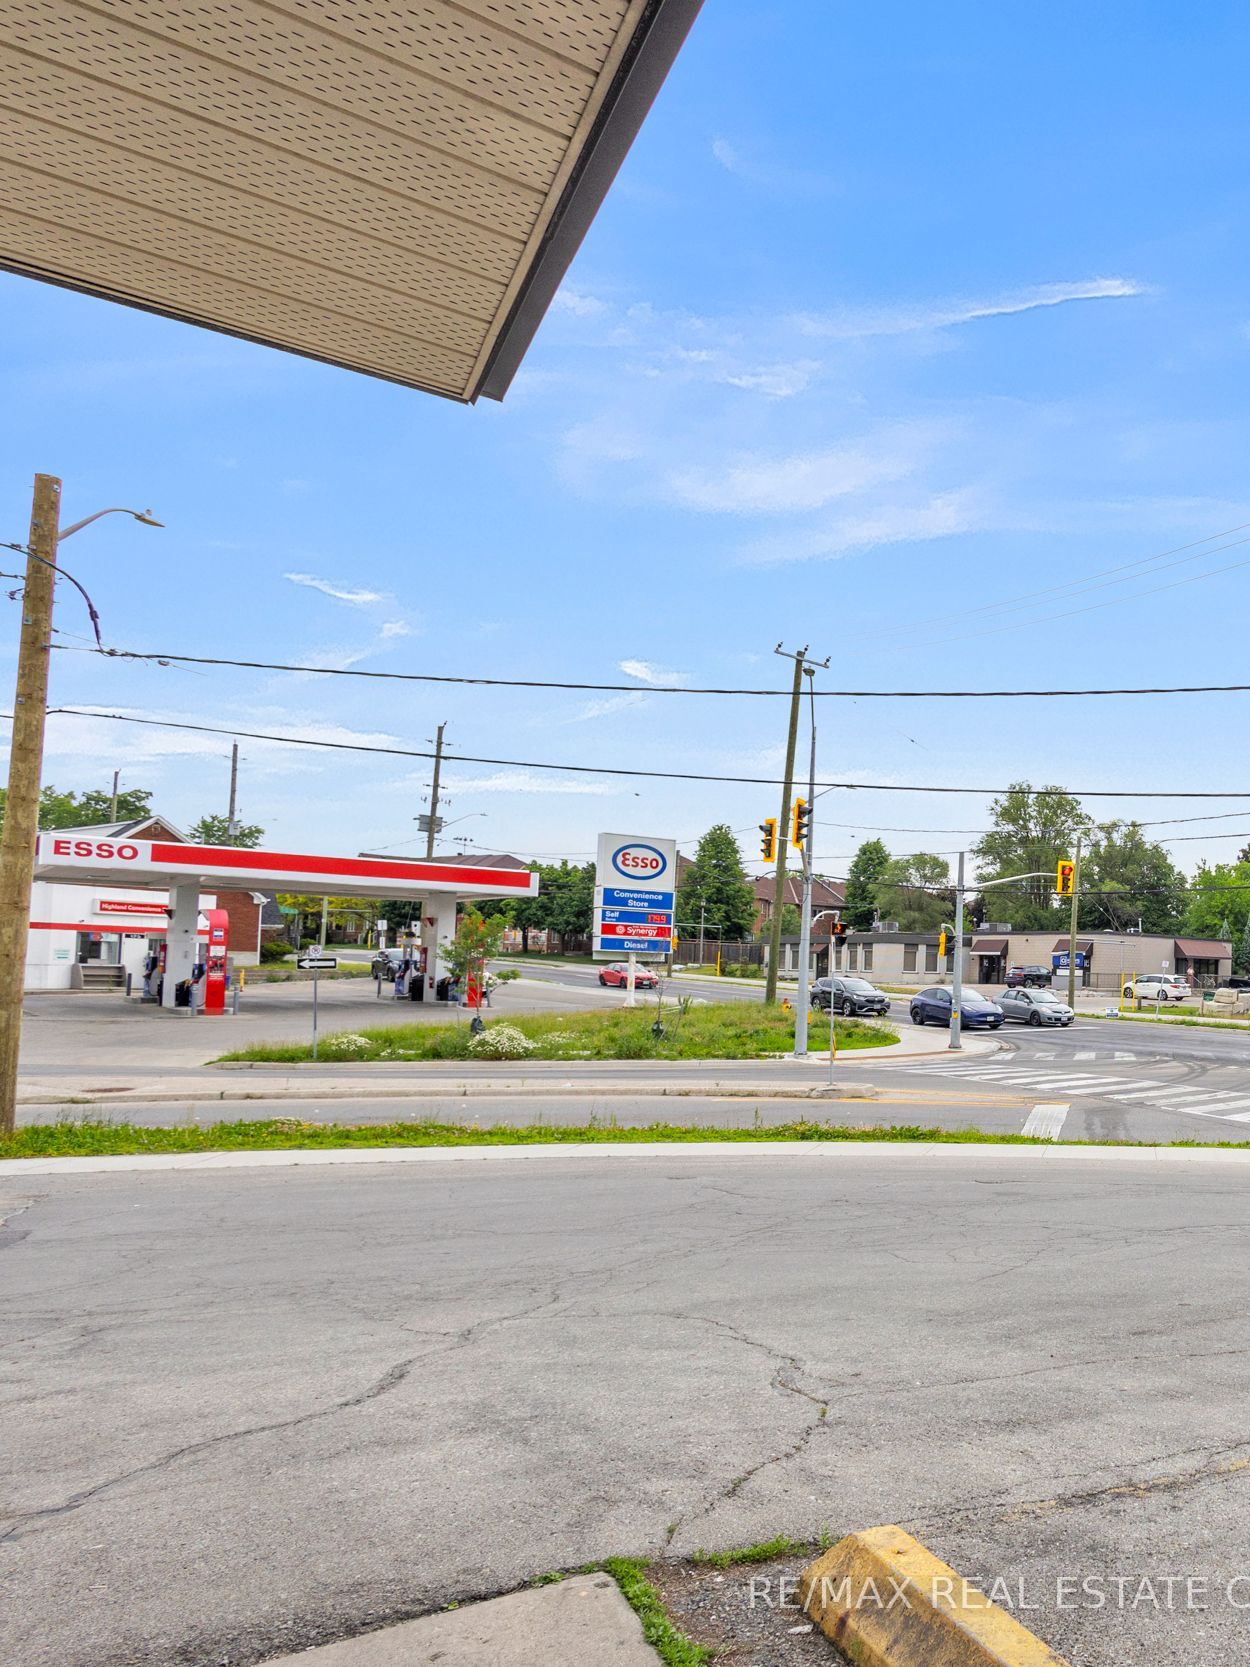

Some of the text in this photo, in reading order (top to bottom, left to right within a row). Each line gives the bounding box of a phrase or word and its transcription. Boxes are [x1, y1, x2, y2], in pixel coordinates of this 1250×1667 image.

[53, 839, 139, 861] ESSO
[613, 890, 663, 900] Convenience
[102, 903, 128, 911] Highland
[127, 904, 162, 912] Convenience
[627, 899, 649, 907] Store
[605, 910, 620, 918] Self
[626, 926, 658, 936] Synergy
[624, 941, 648, 949] Diesel
